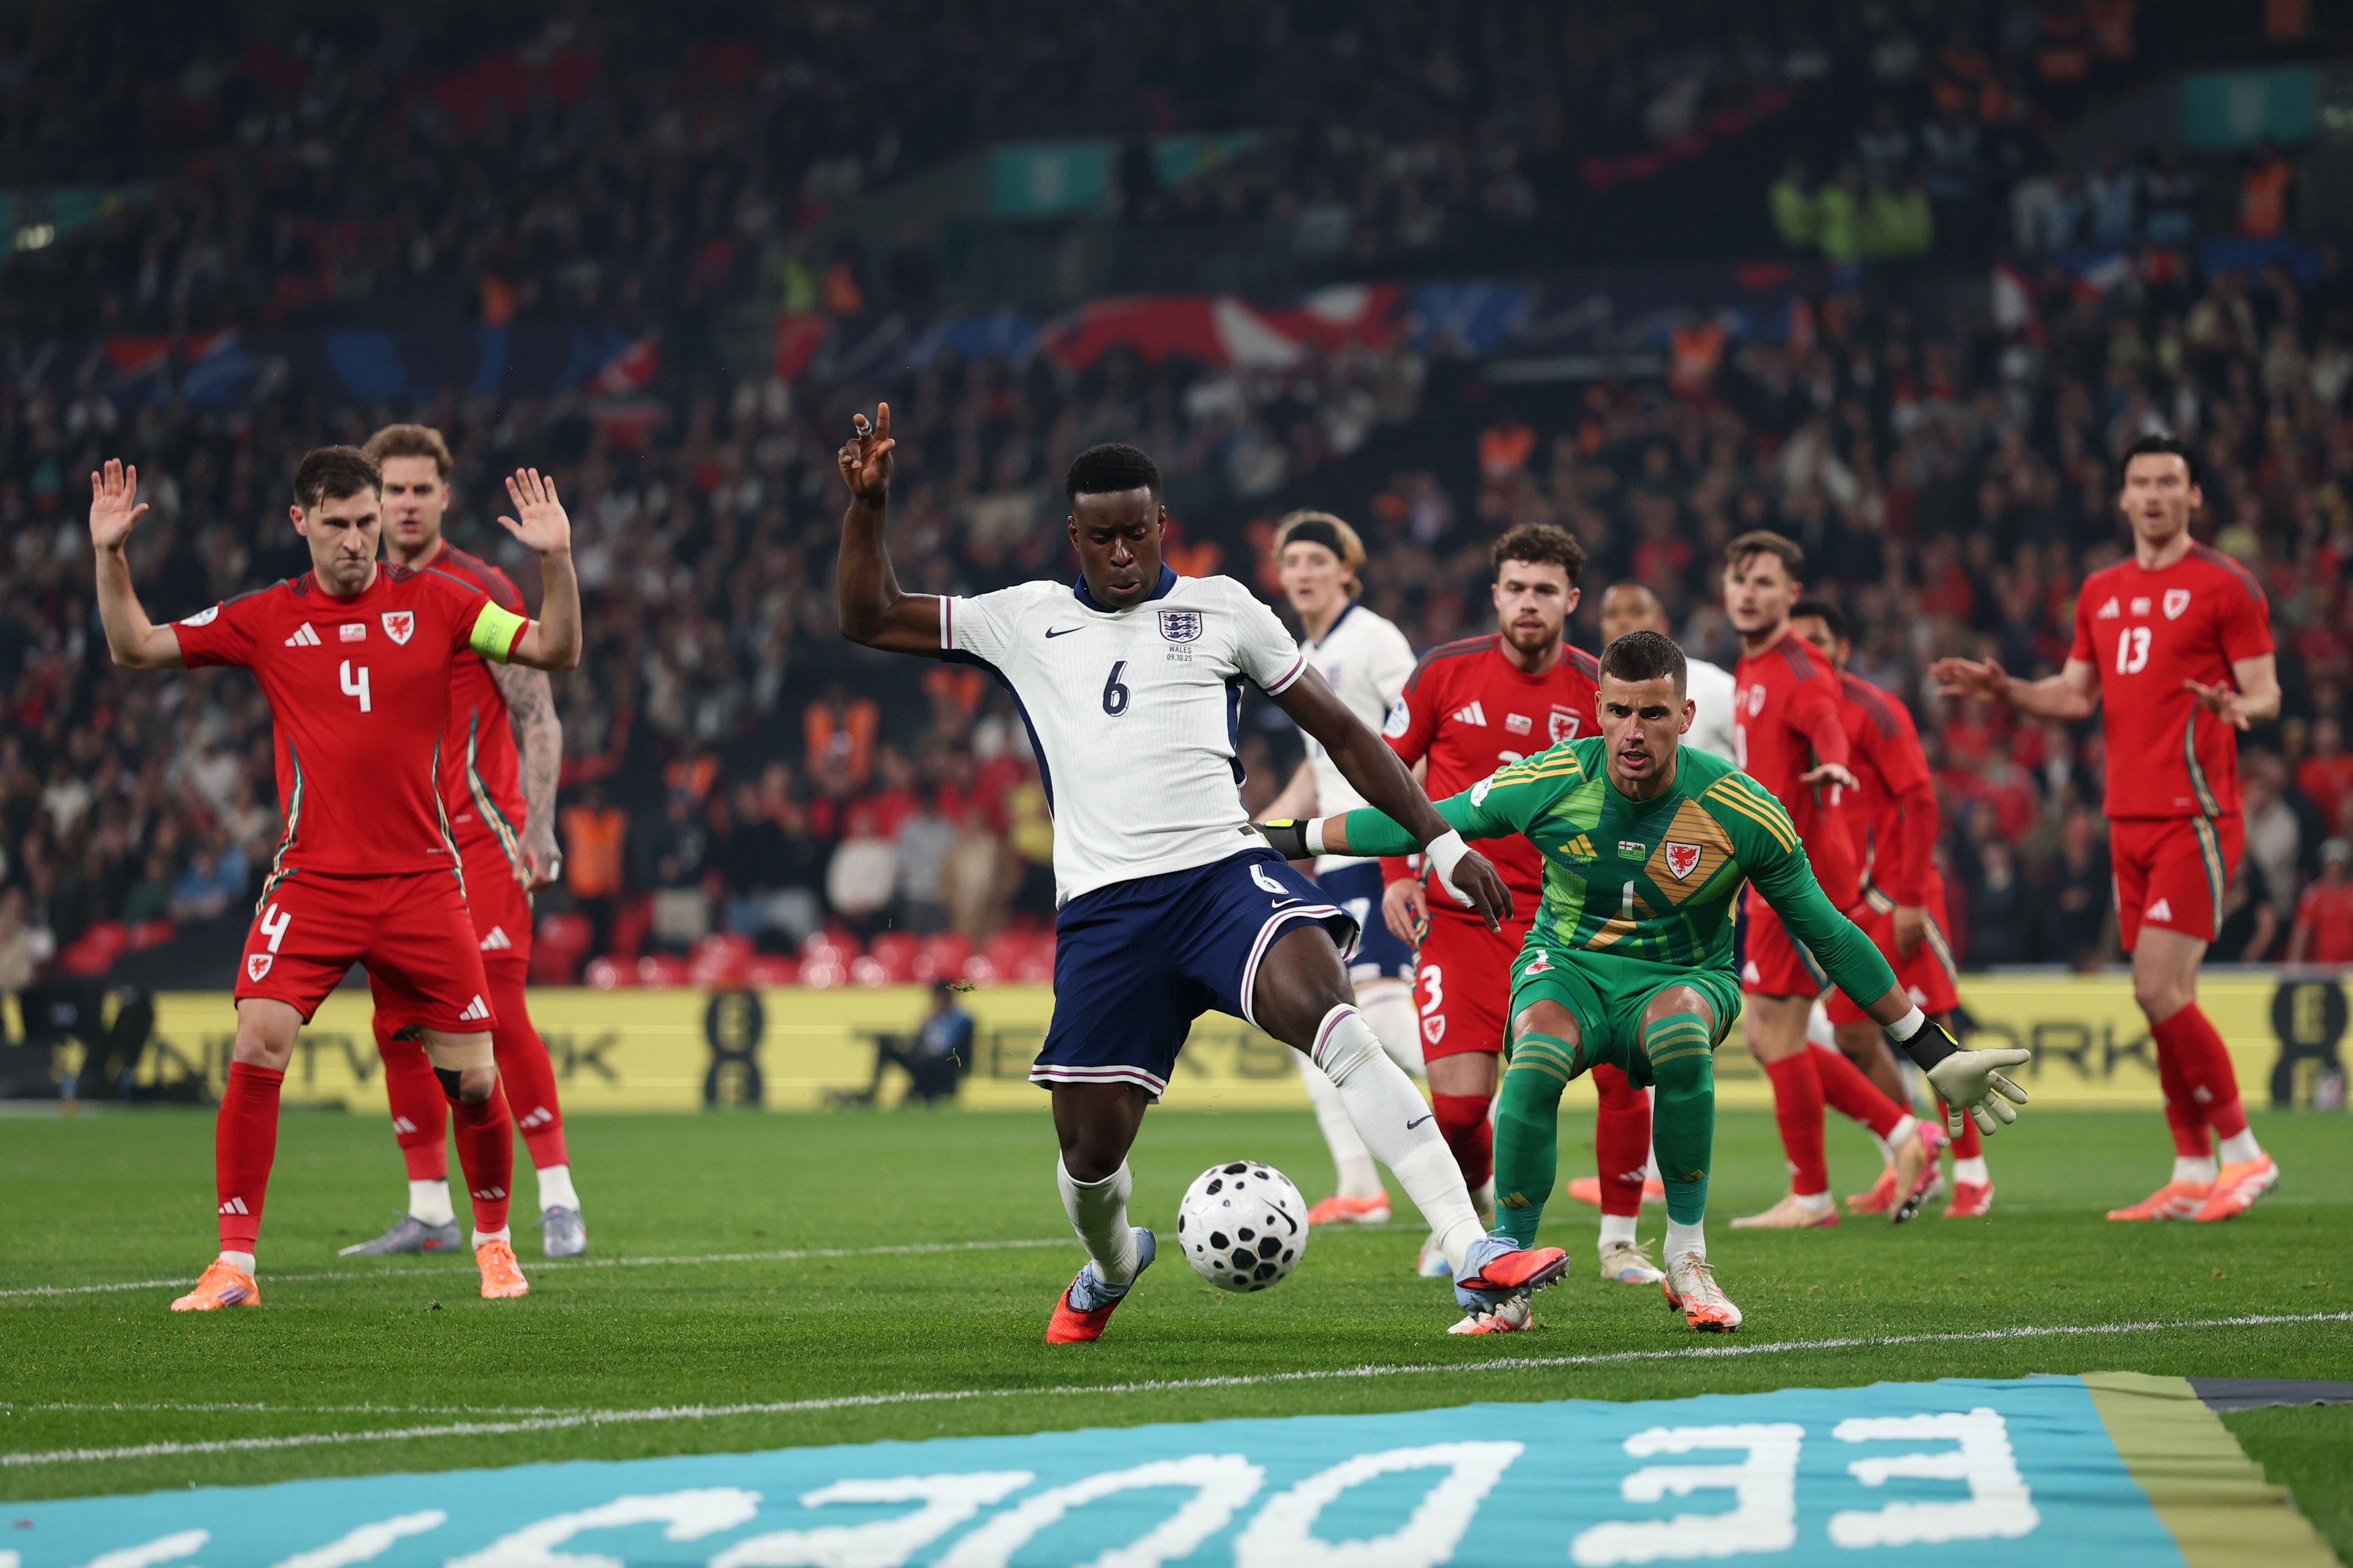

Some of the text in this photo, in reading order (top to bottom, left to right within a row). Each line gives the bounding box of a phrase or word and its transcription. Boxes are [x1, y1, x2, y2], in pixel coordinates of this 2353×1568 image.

[1169, 646, 1192, 654] WALES
[2116, 626, 2152, 675] 13
[340, 659, 372, 713] 4
[1102, 661, 1130, 717] 6
[1249, 864, 1289, 895] 6
[1622, 880, 1634, 919] 1
[259, 903, 292, 954] 4
[1420, 964, 1444, 1016] 3
